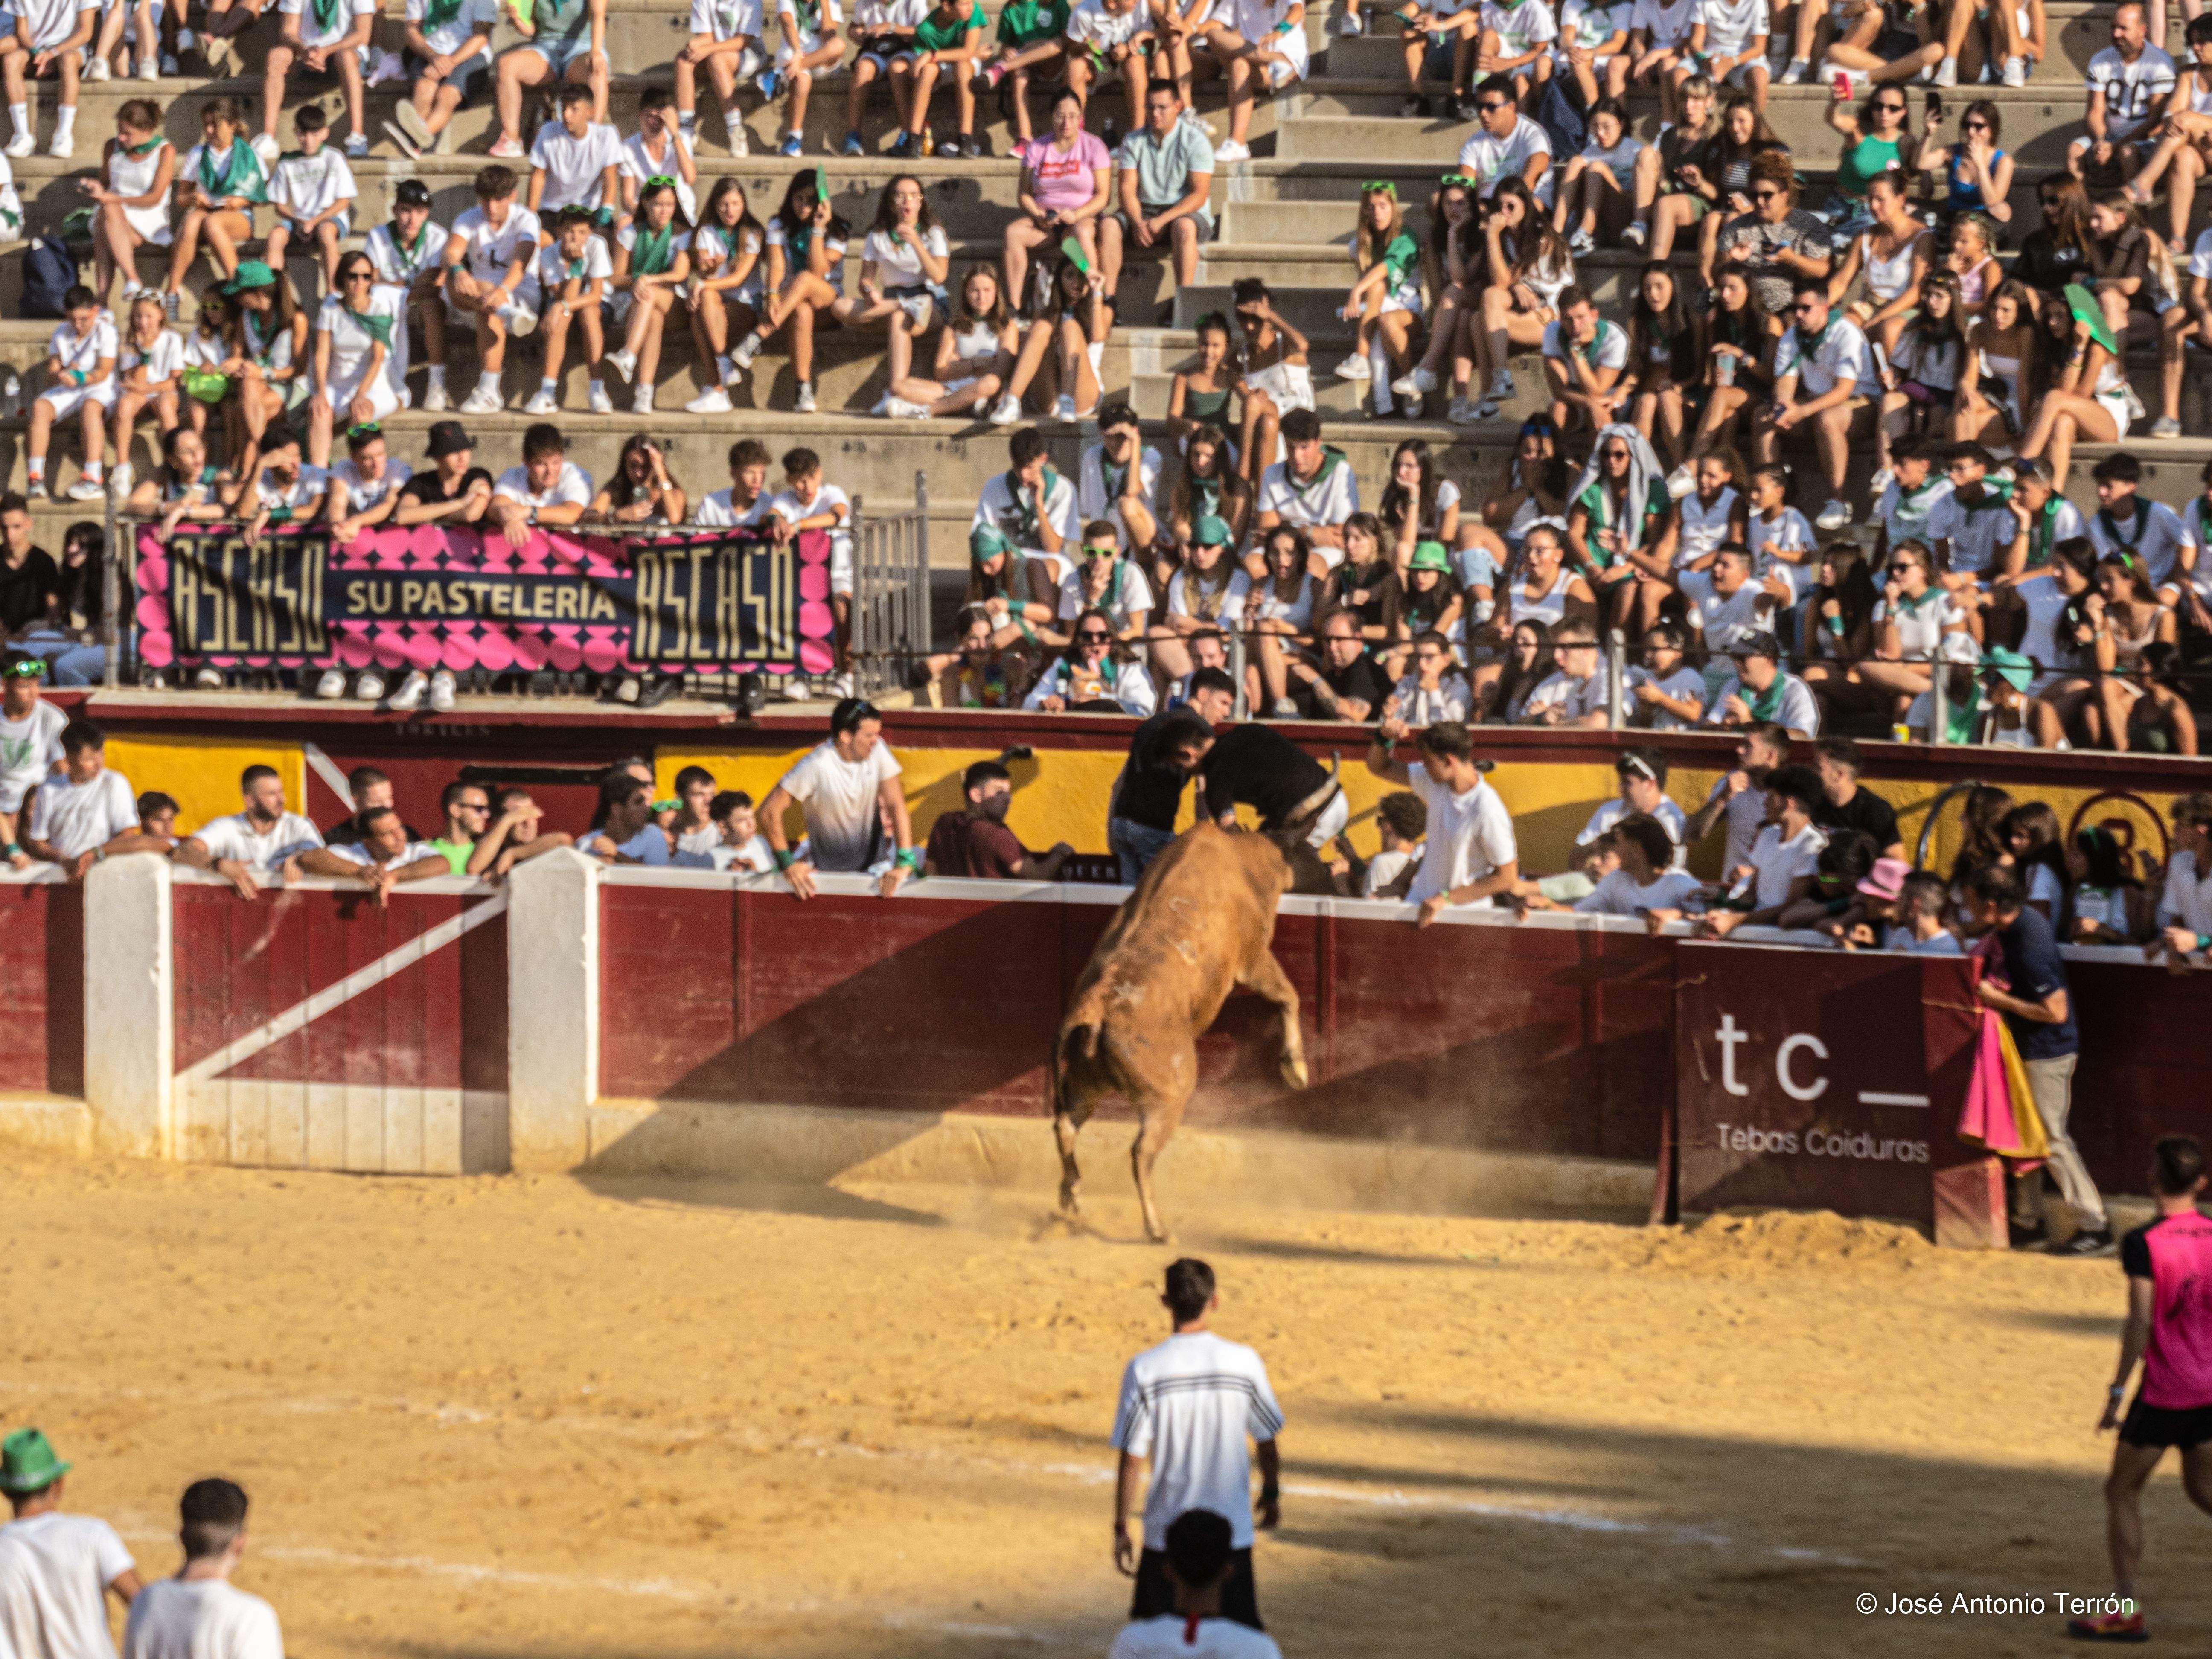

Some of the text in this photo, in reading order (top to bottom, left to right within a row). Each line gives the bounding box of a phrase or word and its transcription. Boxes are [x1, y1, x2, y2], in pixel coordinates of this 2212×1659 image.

[172, 538, 326, 652] ASCASO
[346, 580, 393, 615] SU
[634, 545, 795, 659] ASCASO
[1716, 1122, 1930, 1164] Tebas Coiduras
